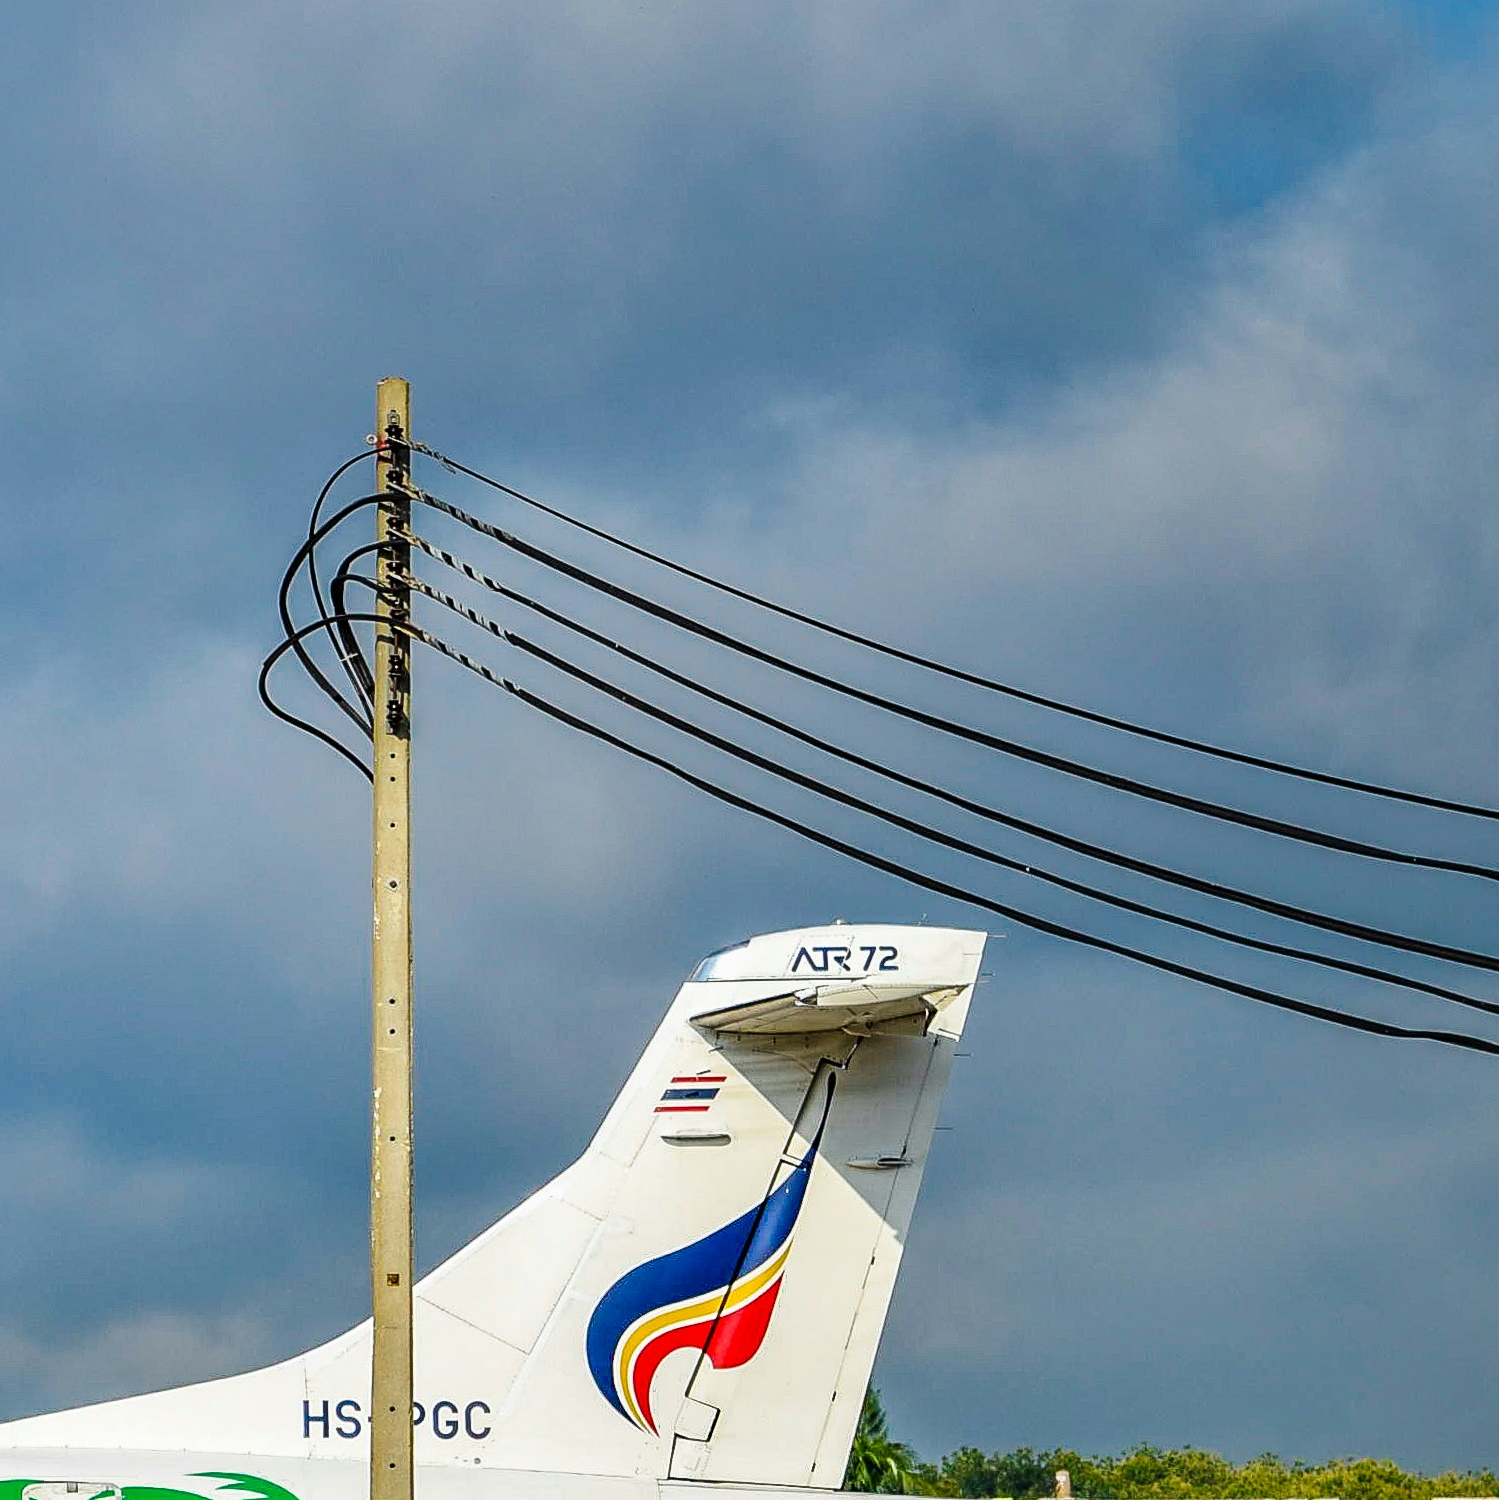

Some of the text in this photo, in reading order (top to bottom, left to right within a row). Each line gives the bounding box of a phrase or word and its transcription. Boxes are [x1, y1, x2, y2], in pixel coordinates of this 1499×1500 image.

[791, 946, 899, 972] ATR 72
[303, 1399, 491, 1440] HSGC
